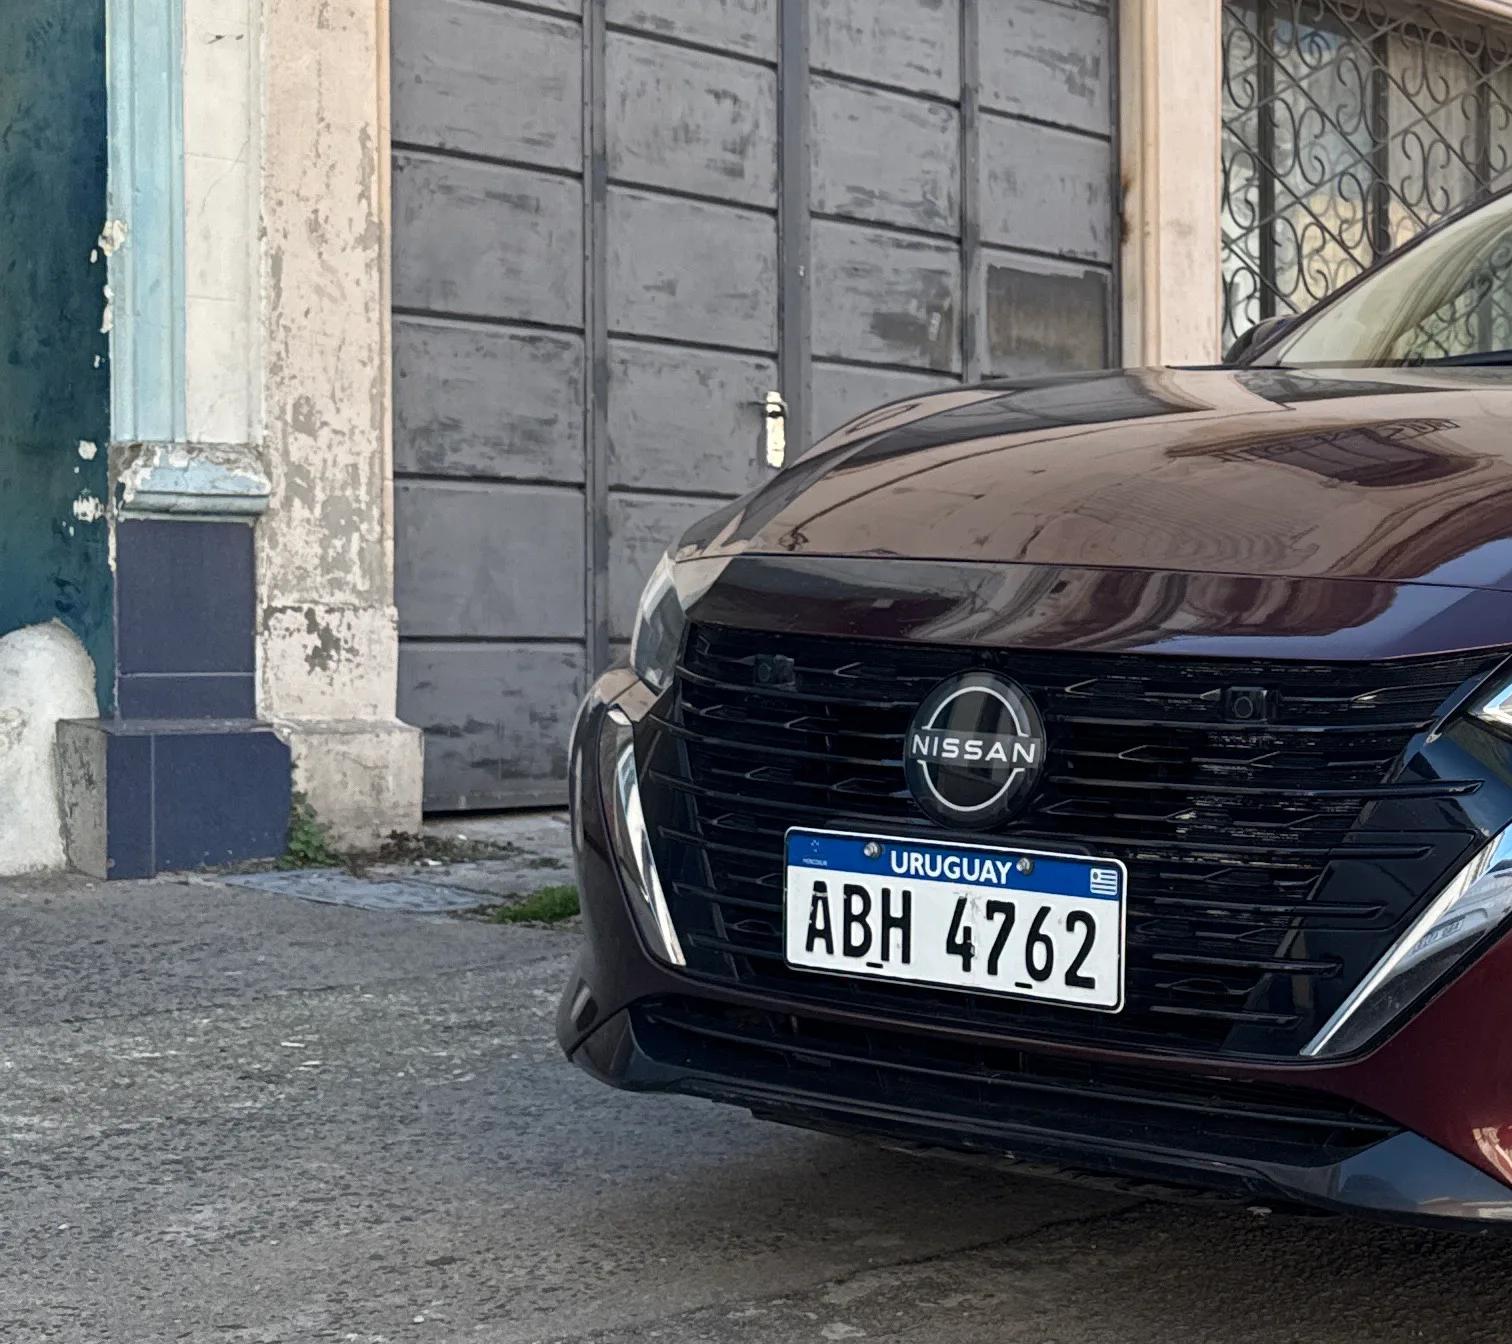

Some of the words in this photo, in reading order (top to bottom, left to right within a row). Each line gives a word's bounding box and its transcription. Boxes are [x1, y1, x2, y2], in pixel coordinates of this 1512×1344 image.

[911, 734, 1036, 763] NISSAN
[890, 850, 1013, 885] URUGUAY
[805, 880, 912, 965] ABH
[946, 896, 1097, 989] 4762
